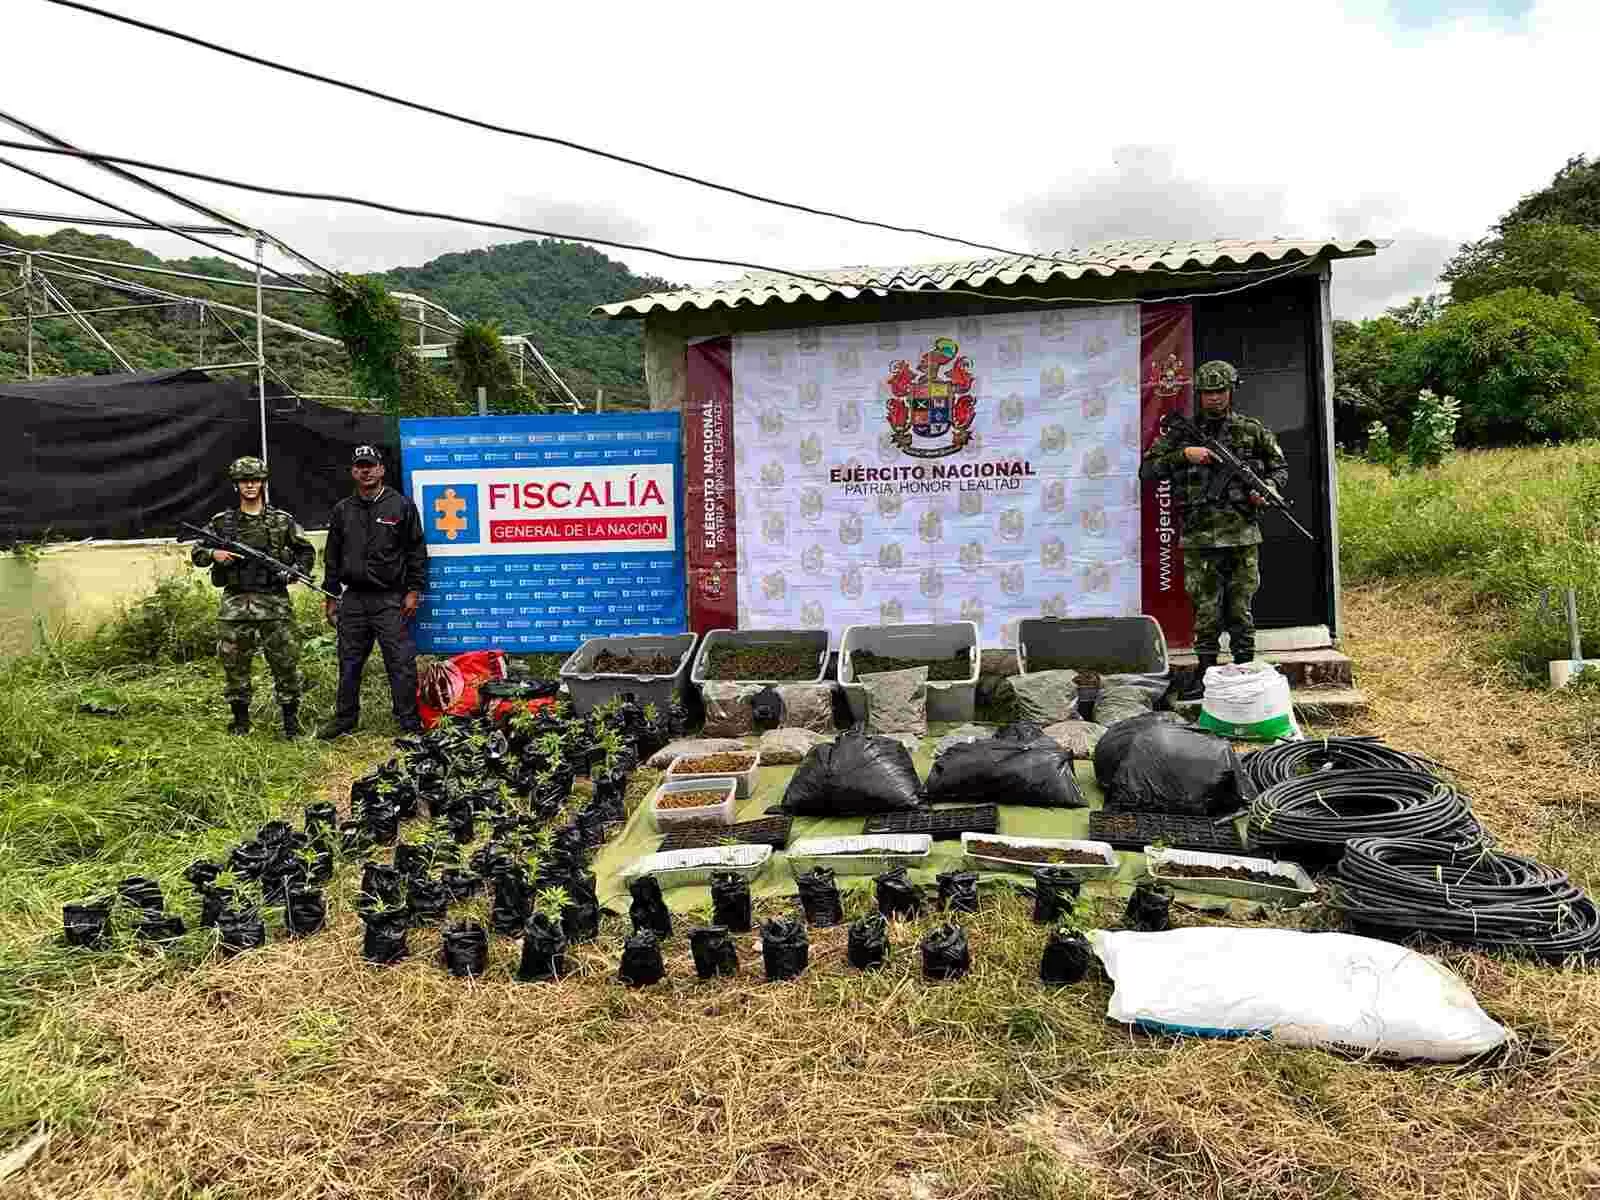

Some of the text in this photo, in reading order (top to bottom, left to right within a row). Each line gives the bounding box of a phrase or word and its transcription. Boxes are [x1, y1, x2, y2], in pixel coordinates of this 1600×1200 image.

[703, 399, 714, 475] NACIONAL
[714, 400, 726, 543] PATRIA HONOR LEALTAD
[830, 461, 1036, 483] EJÉRCITO NACIONAL
[845, 477, 1020, 496] PATRIA HONOR LEALTAD
[488, 472, 665, 510] FISCALÍA
[494, 519, 663, 538] GENERAL DE LA NACIÓN
